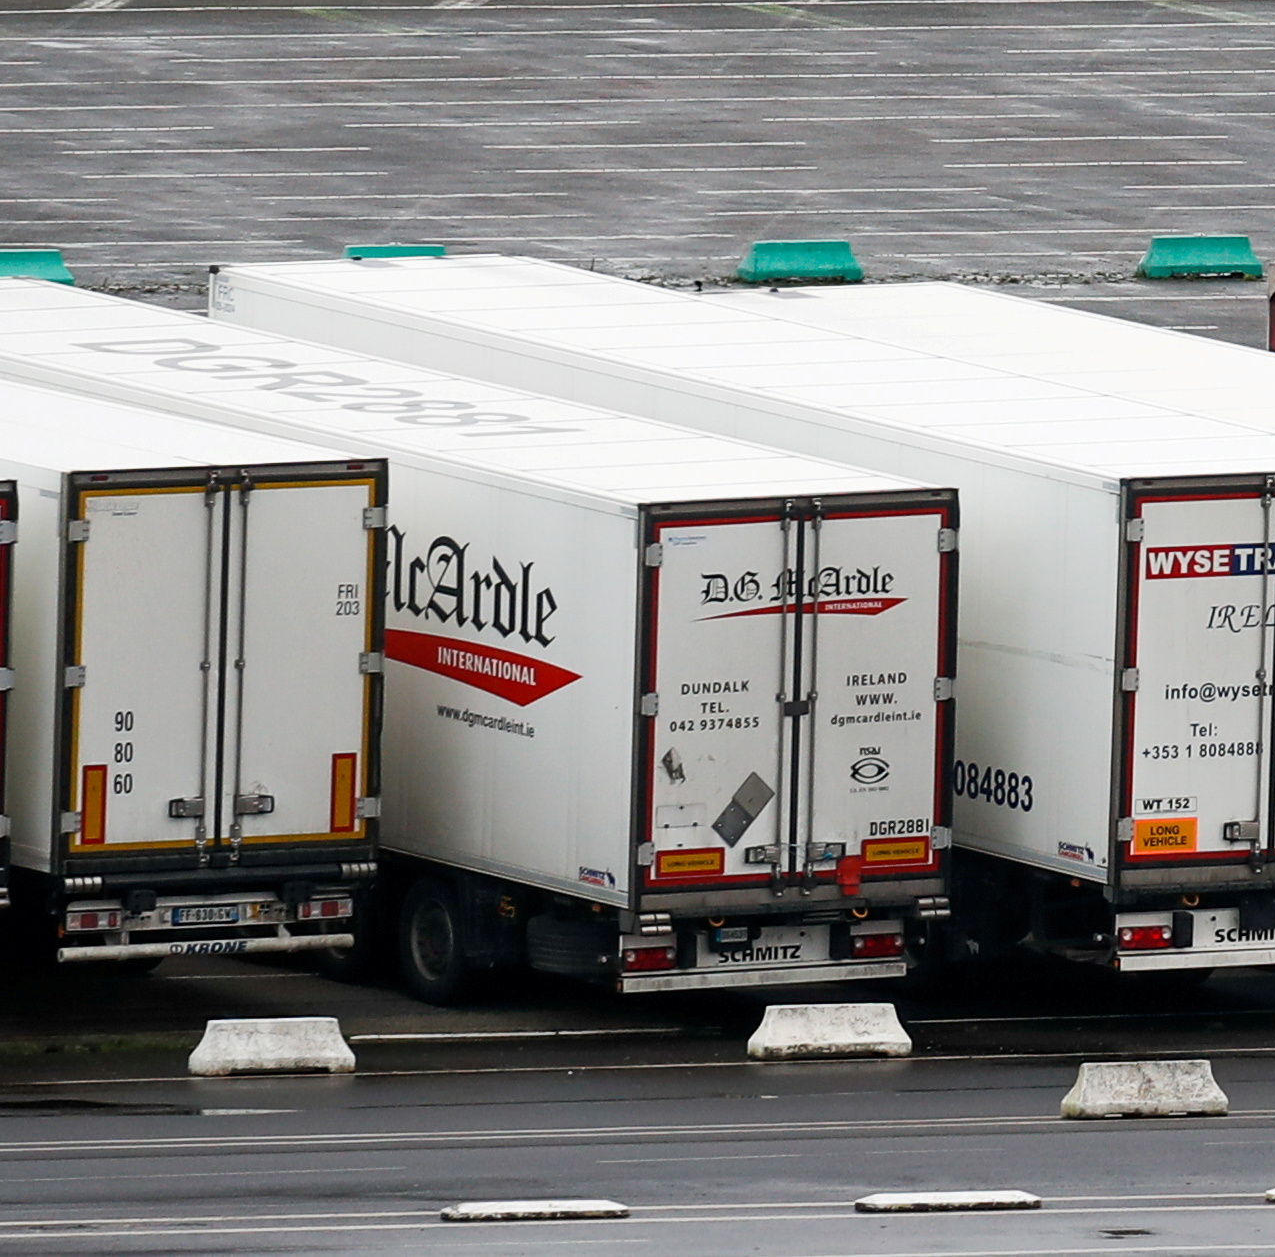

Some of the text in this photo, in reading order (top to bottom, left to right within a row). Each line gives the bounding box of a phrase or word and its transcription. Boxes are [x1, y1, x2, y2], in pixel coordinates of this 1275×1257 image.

[1148, 548, 1231, 575] WYSE
[337, 584, 359, 599] FRI
[335, 601, 360, 616] 203
[825, 601, 883, 611] INTERNATIONAL
[437, 646, 537, 686] INTERNATIONAL
[846, 672, 907, 687] IRELAND
[681, 680, 750, 696] DUNDALK
[701, 702, 730, 714] TEL.
[114, 710, 134, 732] 90
[436, 704, 535, 738] www.dgmcardleint.ie
[669, 717, 760, 732] 042 9374855
[830, 711, 922, 727] dgmcardleint.ie
[1190, 723, 1218, 737] Tel:
[113, 741, 134, 763] 80
[1142, 745, 1179, 760] +353
[1186, 744, 1192, 758] 1
[113, 773, 133, 794] 60
[953, 760, 1033, 812] 084883
[1142, 797, 1190, 811] WT 152
[869, 818, 929, 836] DGR2881
[1150, 825, 1180, 836] LONG
[1143, 835, 1187, 847] VEHICLE
[186, 940, 248, 954] KRONE
[718, 943, 803, 964] SCHMITZ
